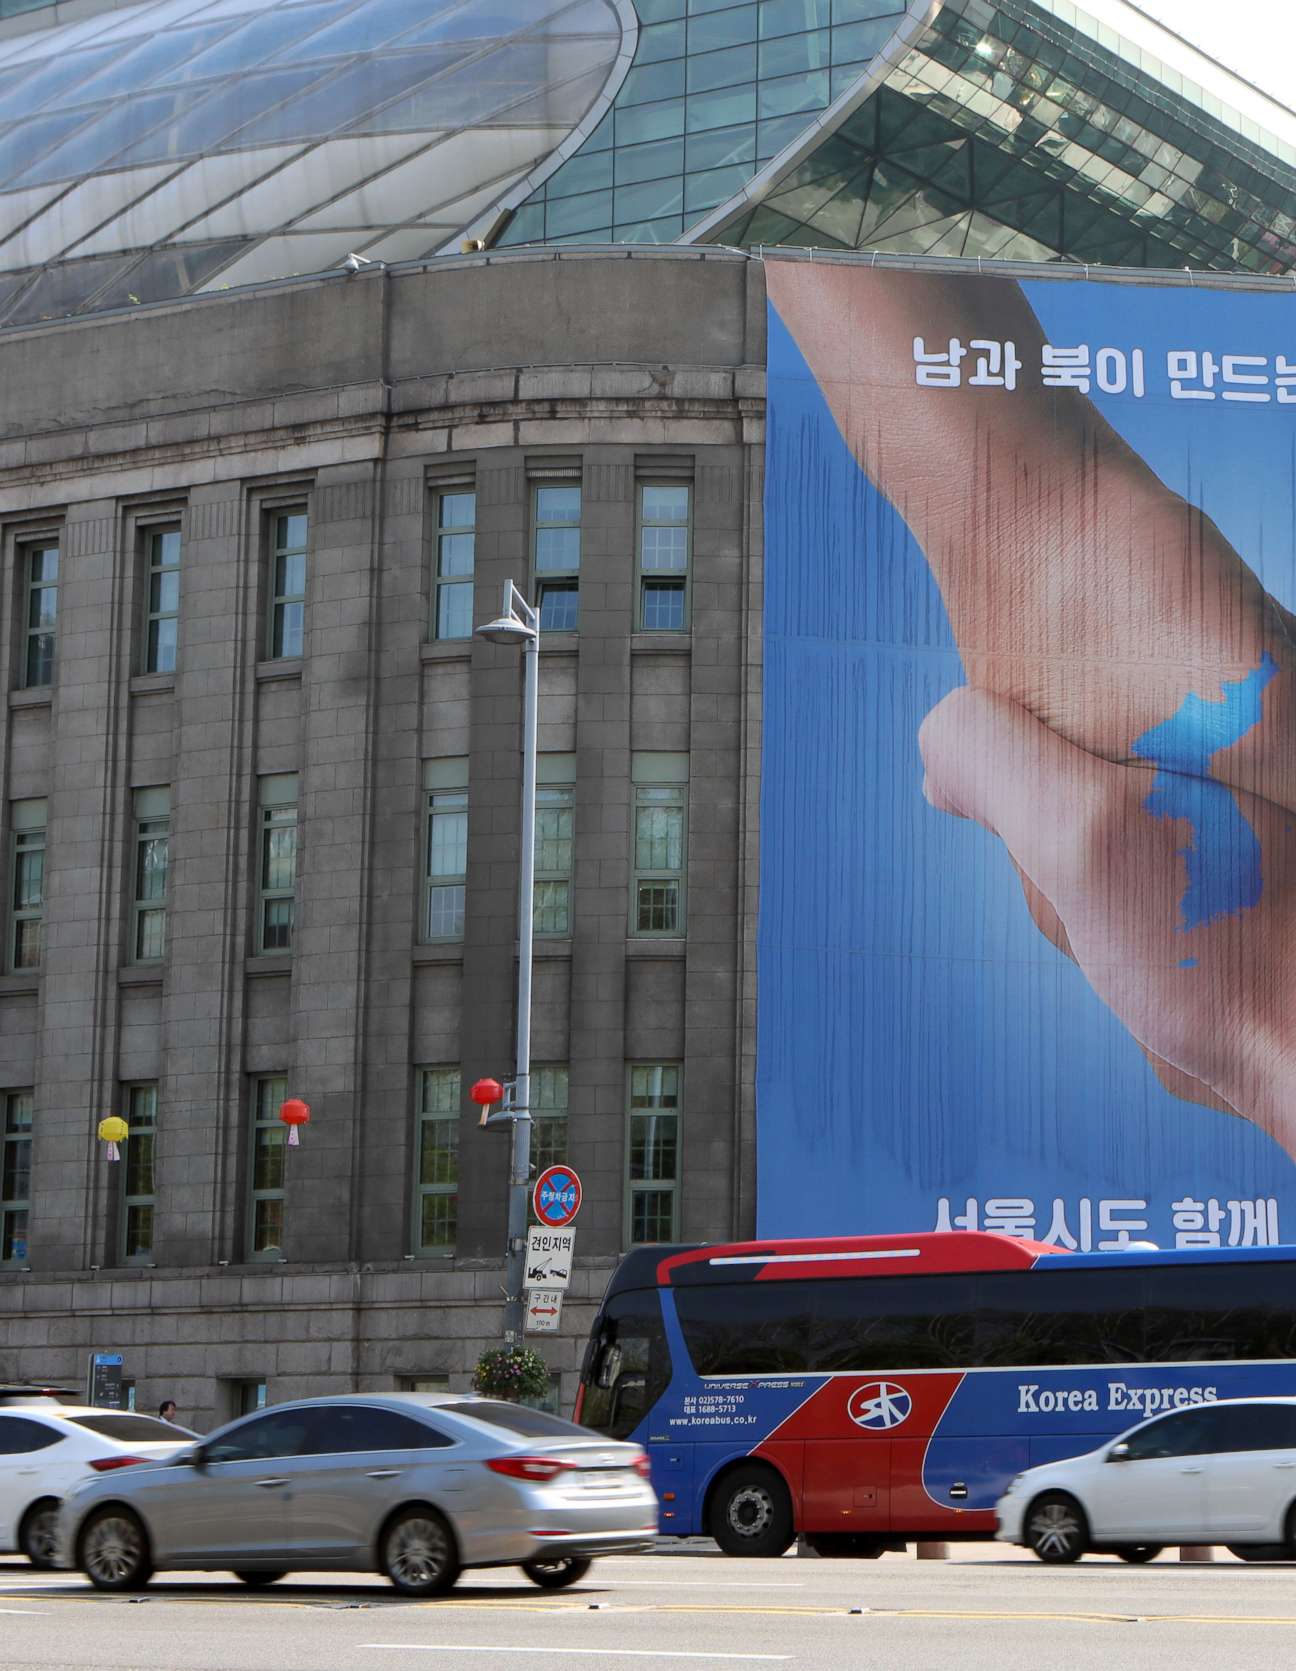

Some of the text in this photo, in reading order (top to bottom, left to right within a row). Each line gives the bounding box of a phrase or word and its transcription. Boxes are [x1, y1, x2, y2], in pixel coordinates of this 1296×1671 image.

[913, 336, 1021, 390] 남과
[1041, 344, 1144, 398] 북이
[933, 1197, 1149, 1252] 서울시도
[1171, 1197, 1279, 1248] 함께
[531, 1236, 572, 1252] 견인지역
[1017, 1382, 1218, 1418] Korea Express
[669, 1414, 758, 1426] www.koreabus.co.kr
